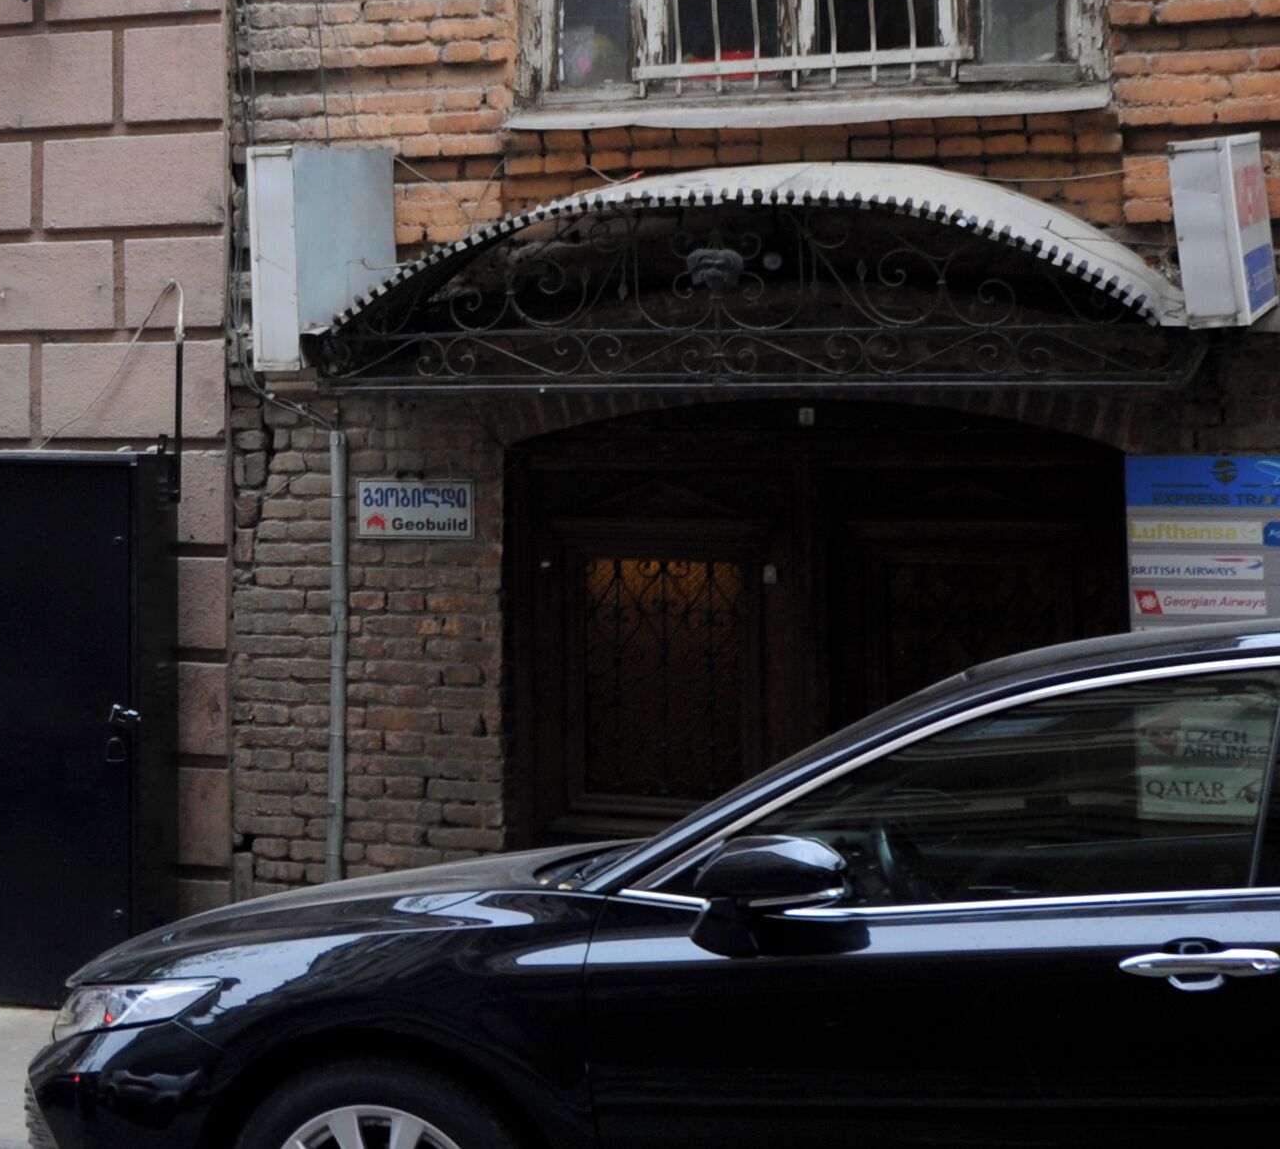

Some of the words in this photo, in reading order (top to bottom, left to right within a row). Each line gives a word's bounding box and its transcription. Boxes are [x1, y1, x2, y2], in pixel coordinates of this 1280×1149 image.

[363, 487, 467, 508] გეობილდი
[1151, 492, 1230, 505] EXPRESS
[391, 517, 468, 532] Geobuild
[1130, 521, 1238, 540] Lufthansa
[1130, 566, 1180, 576] BRITISH
[1184, 566, 1237, 577] AIRWAYS
[1162, 596, 1217, 610] Georgian
[1219, 596, 1267, 610] Airways
[1184, 730, 1248, 744] CZECH
[1145, 779, 1225, 800] QATAR
